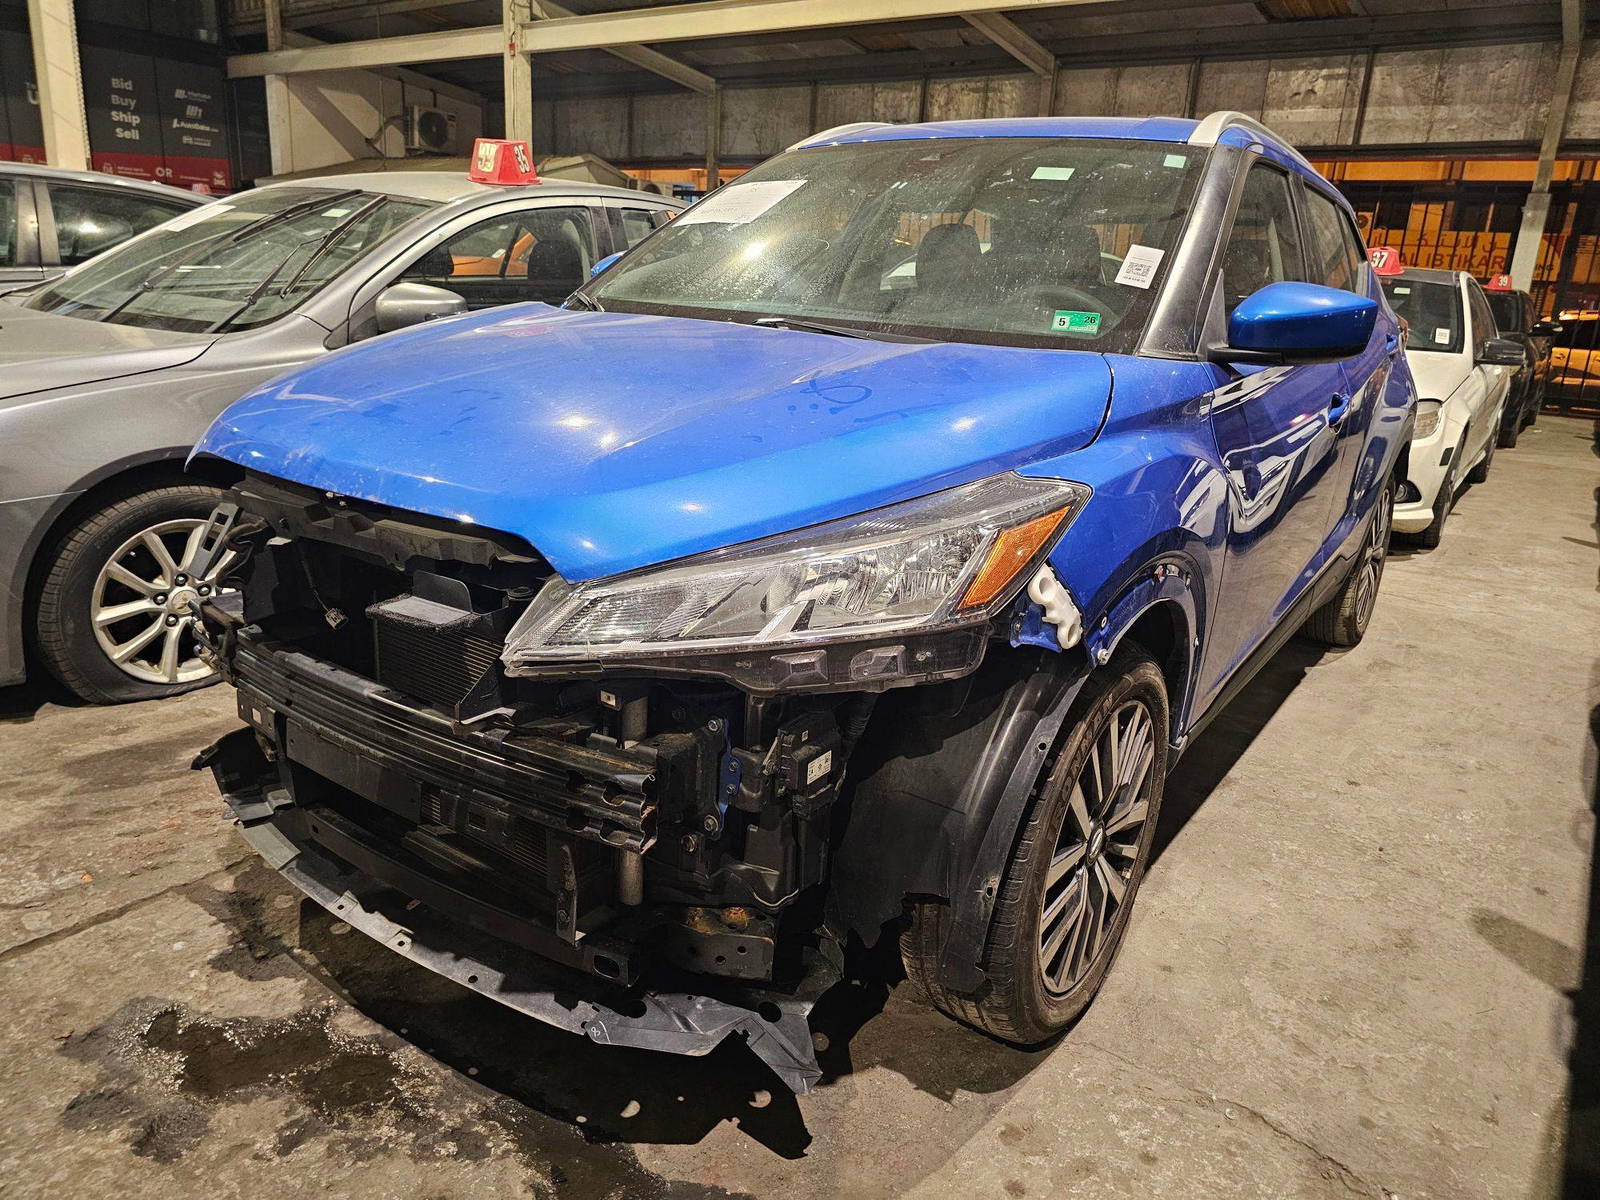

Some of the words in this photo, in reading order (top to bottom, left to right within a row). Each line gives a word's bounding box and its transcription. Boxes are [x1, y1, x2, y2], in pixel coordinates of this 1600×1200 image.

[111, 78, 133, 91] Bid
[111, 95, 136, 110] Buy
[111, 111, 140, 126] Ship
[115, 128, 139, 140] Sell
[513, 144, 531, 174] 35
[155, 167, 172, 177] OR
[1371, 251, 1389, 268] 37
[1425, 252, 1505, 270] IBTIKAR
[1498, 275, 1508, 286] 39
[1058, 317, 1066, 326] 5
[1084, 316, 1096, 324] 26
